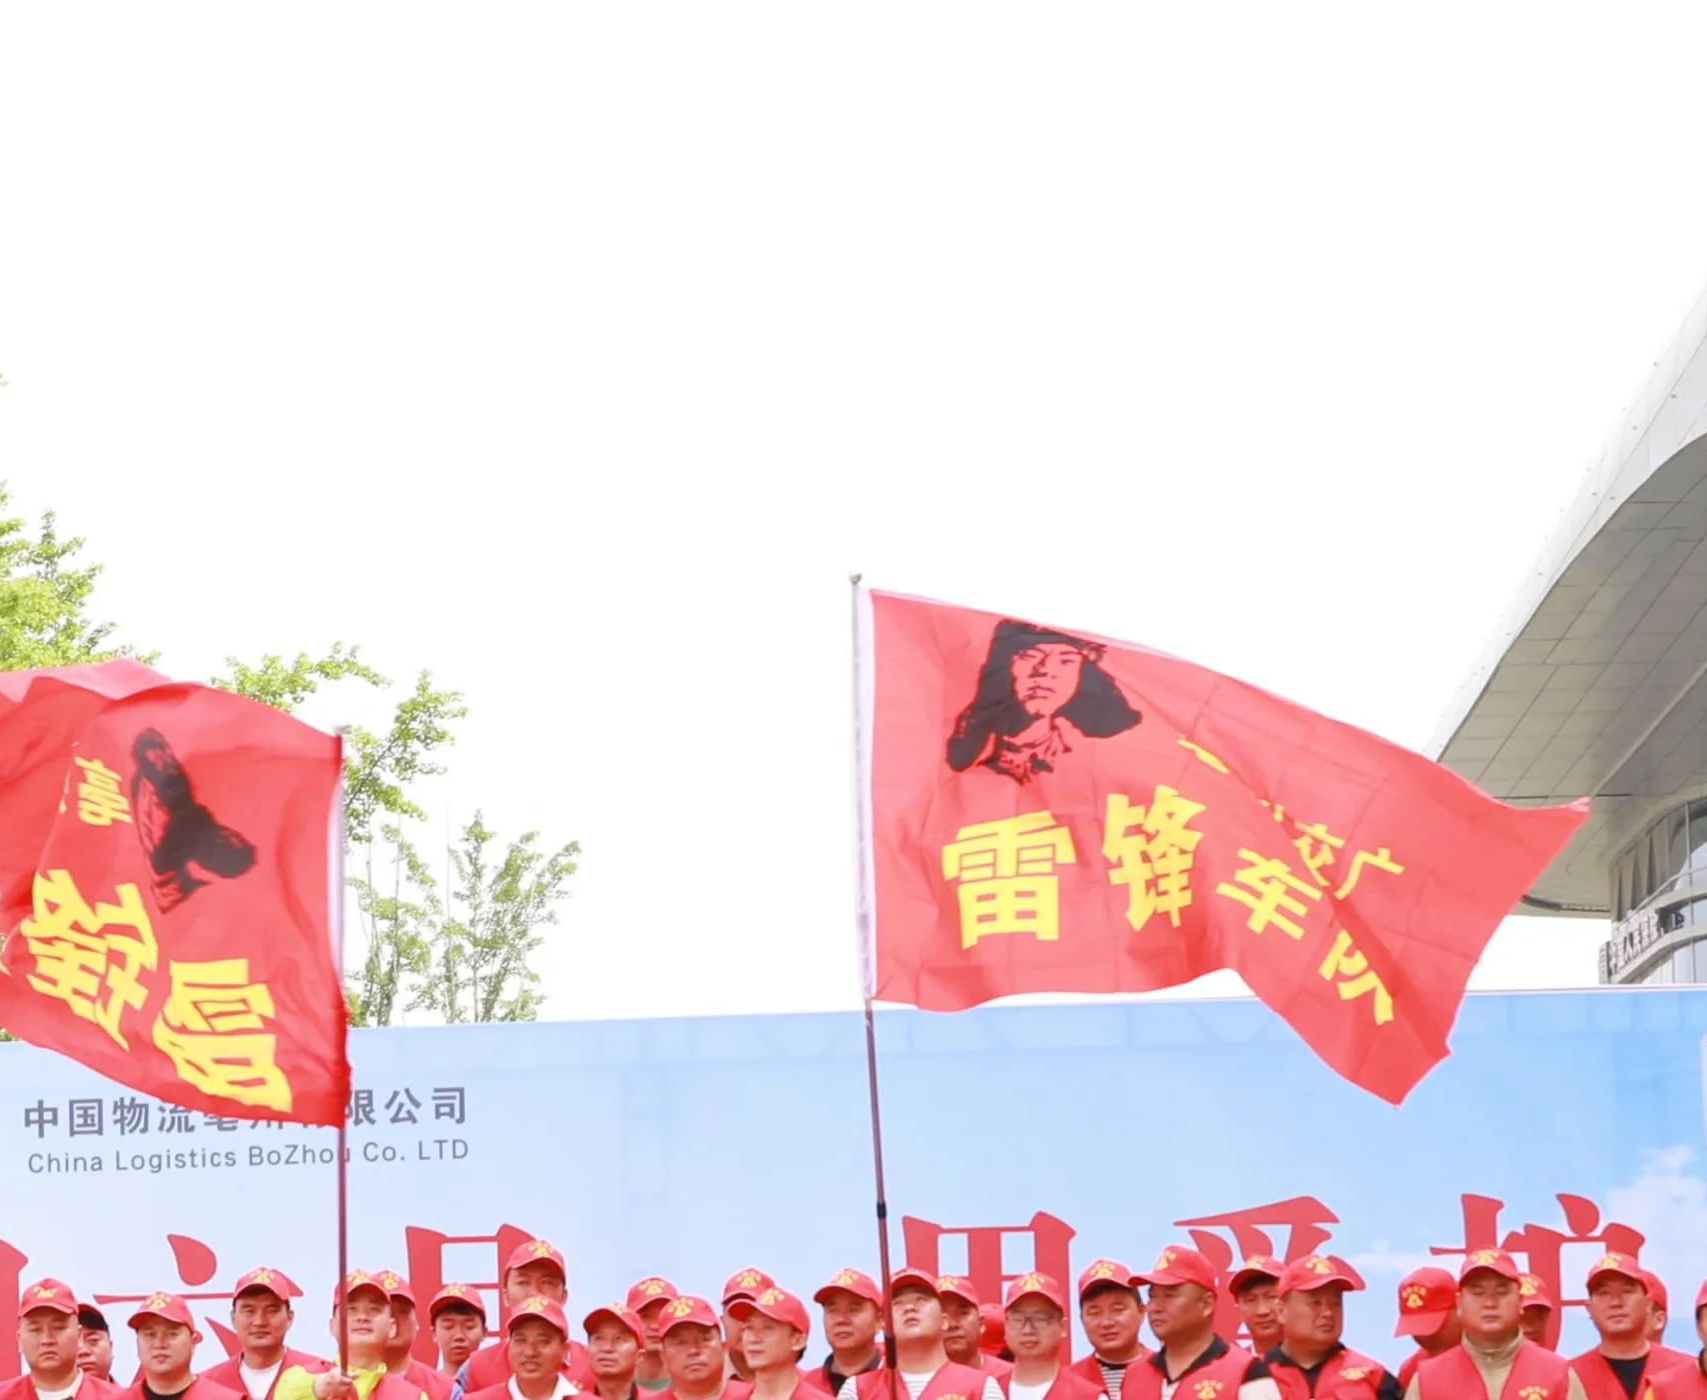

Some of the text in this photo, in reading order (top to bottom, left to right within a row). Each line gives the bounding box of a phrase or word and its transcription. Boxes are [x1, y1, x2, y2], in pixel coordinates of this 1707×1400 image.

[941, 784, 1394, 1026] 雷锋车队
[23, 1086, 467, 1138] 中国物流限公司
[27, 1138, 470, 1174] China Logistics BoZhou Co. LTD
